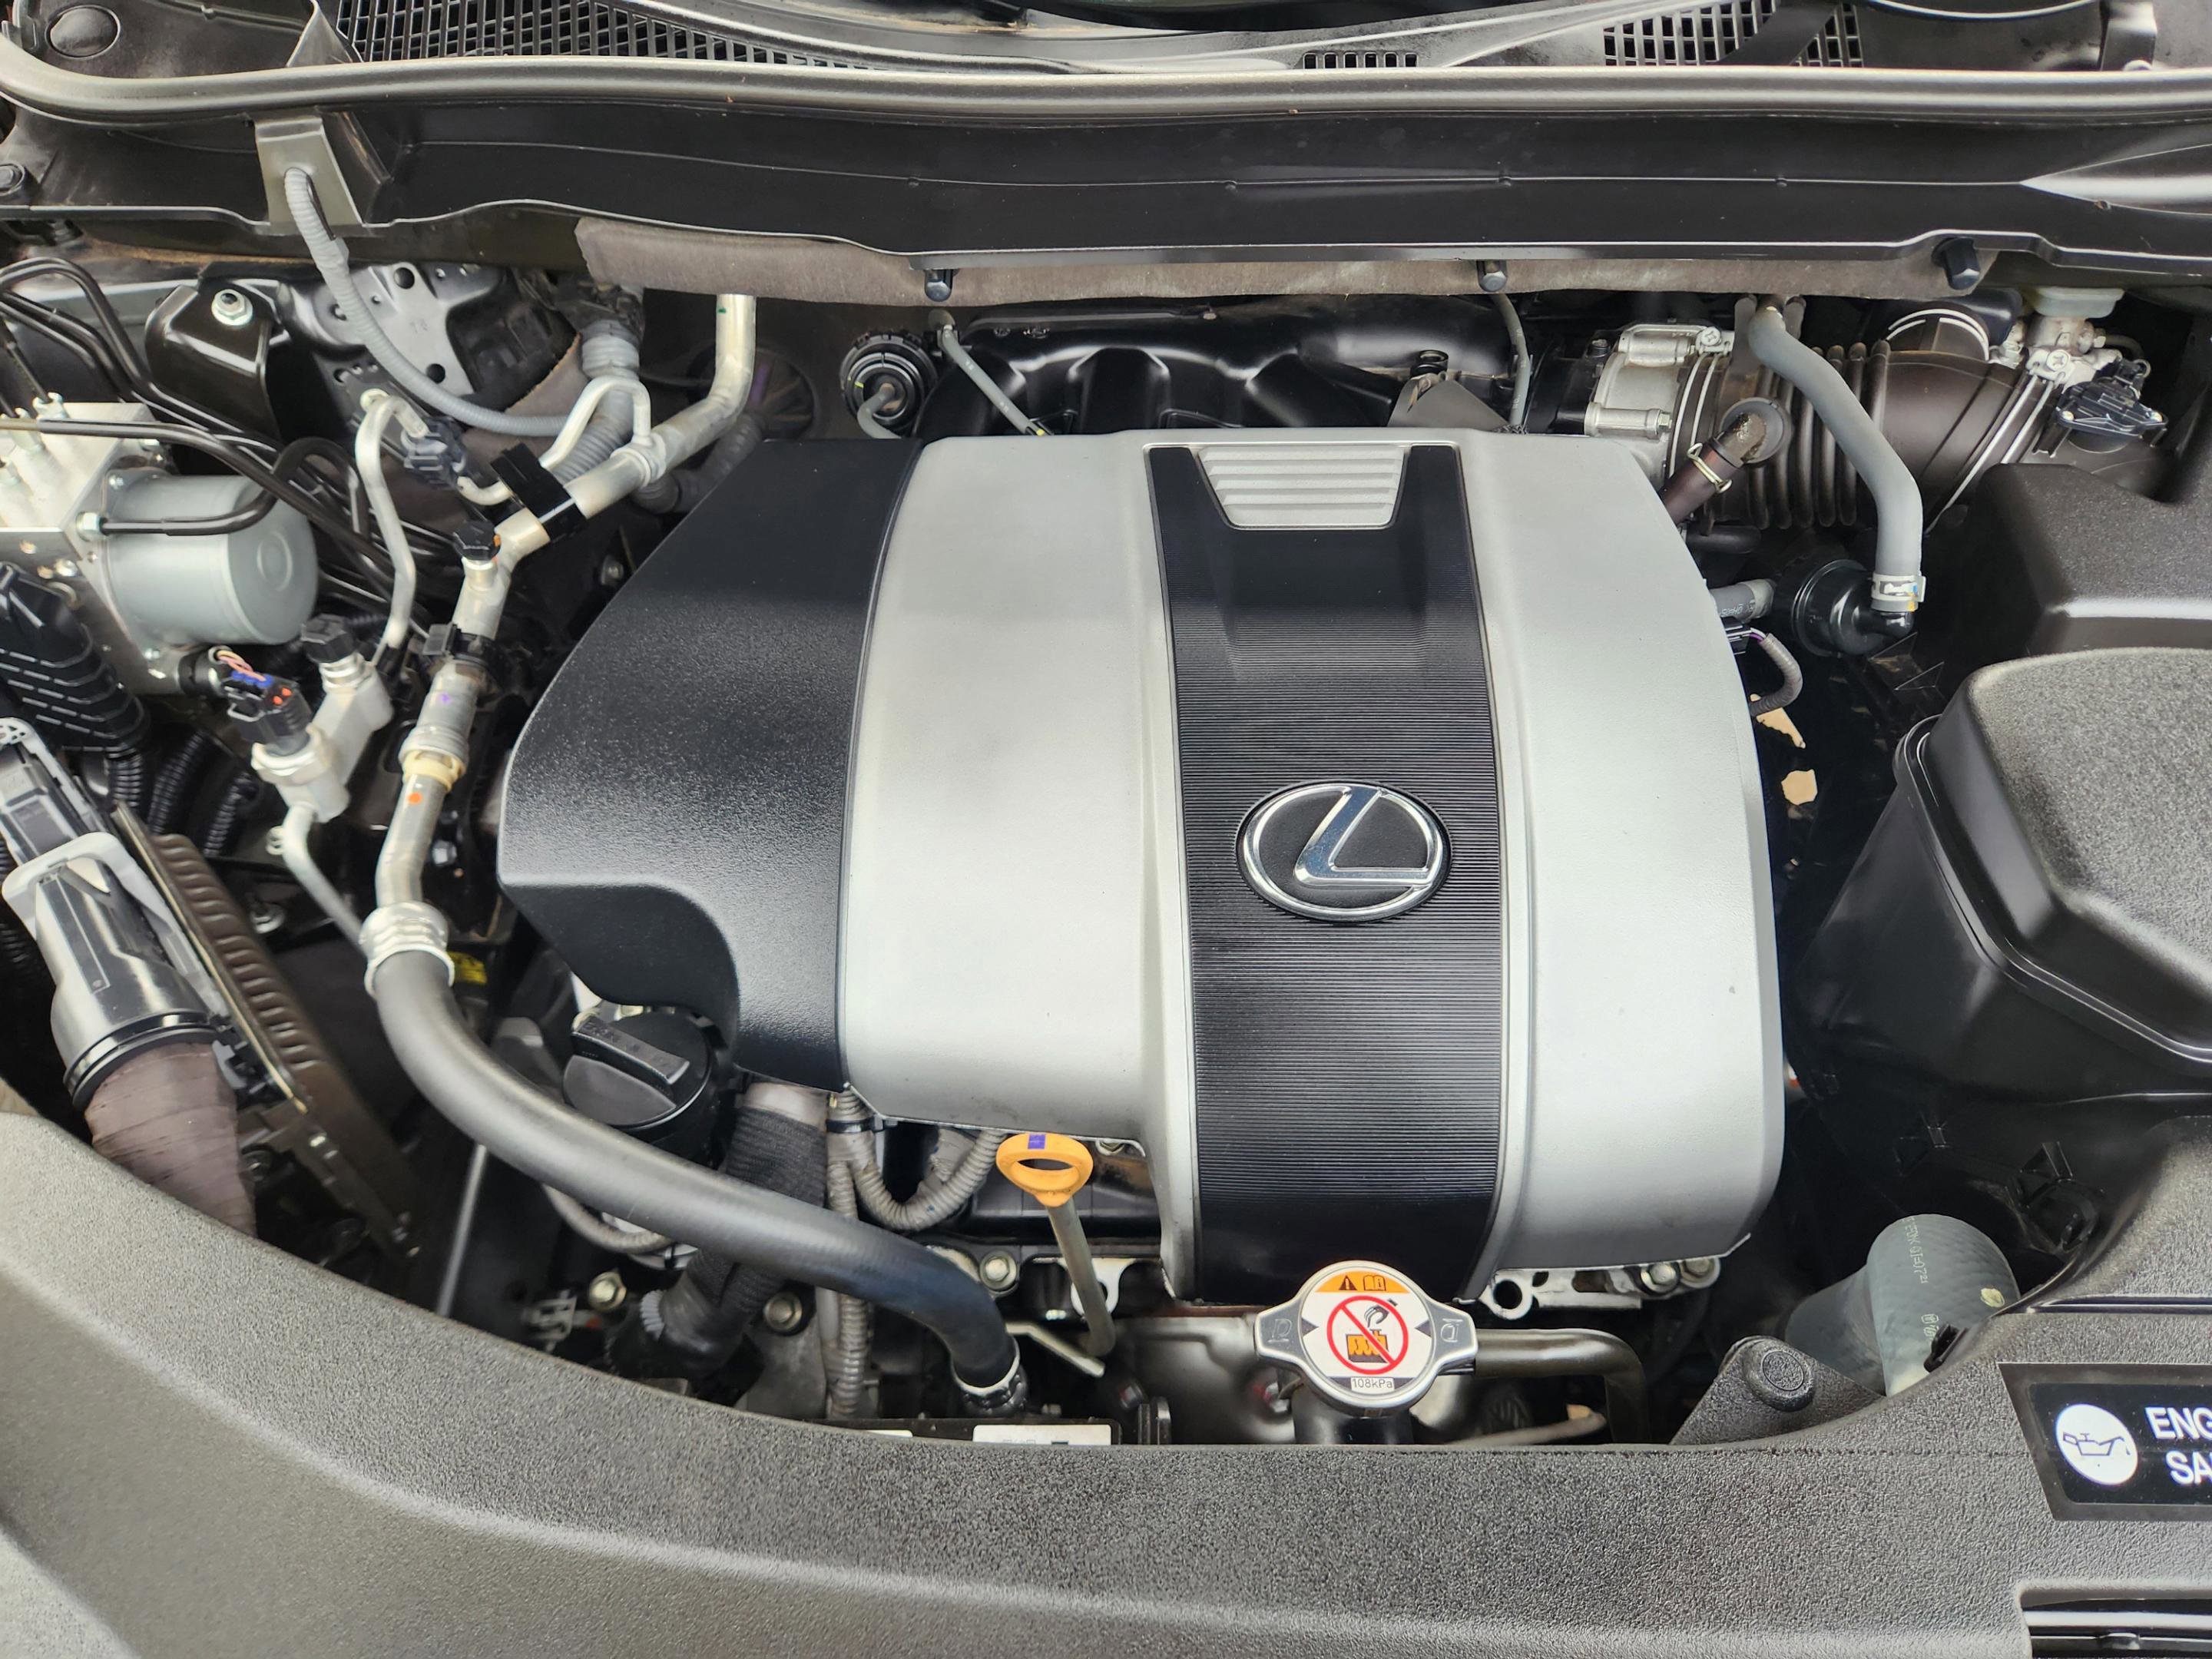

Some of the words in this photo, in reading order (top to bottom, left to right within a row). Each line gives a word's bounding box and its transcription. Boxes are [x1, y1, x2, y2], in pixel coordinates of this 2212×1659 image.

[1352, 1378, 1393, 1389] 108kPa
[2144, 1406, 2212, 1440] ENG
[2166, 1450, 2212, 1485] SA
